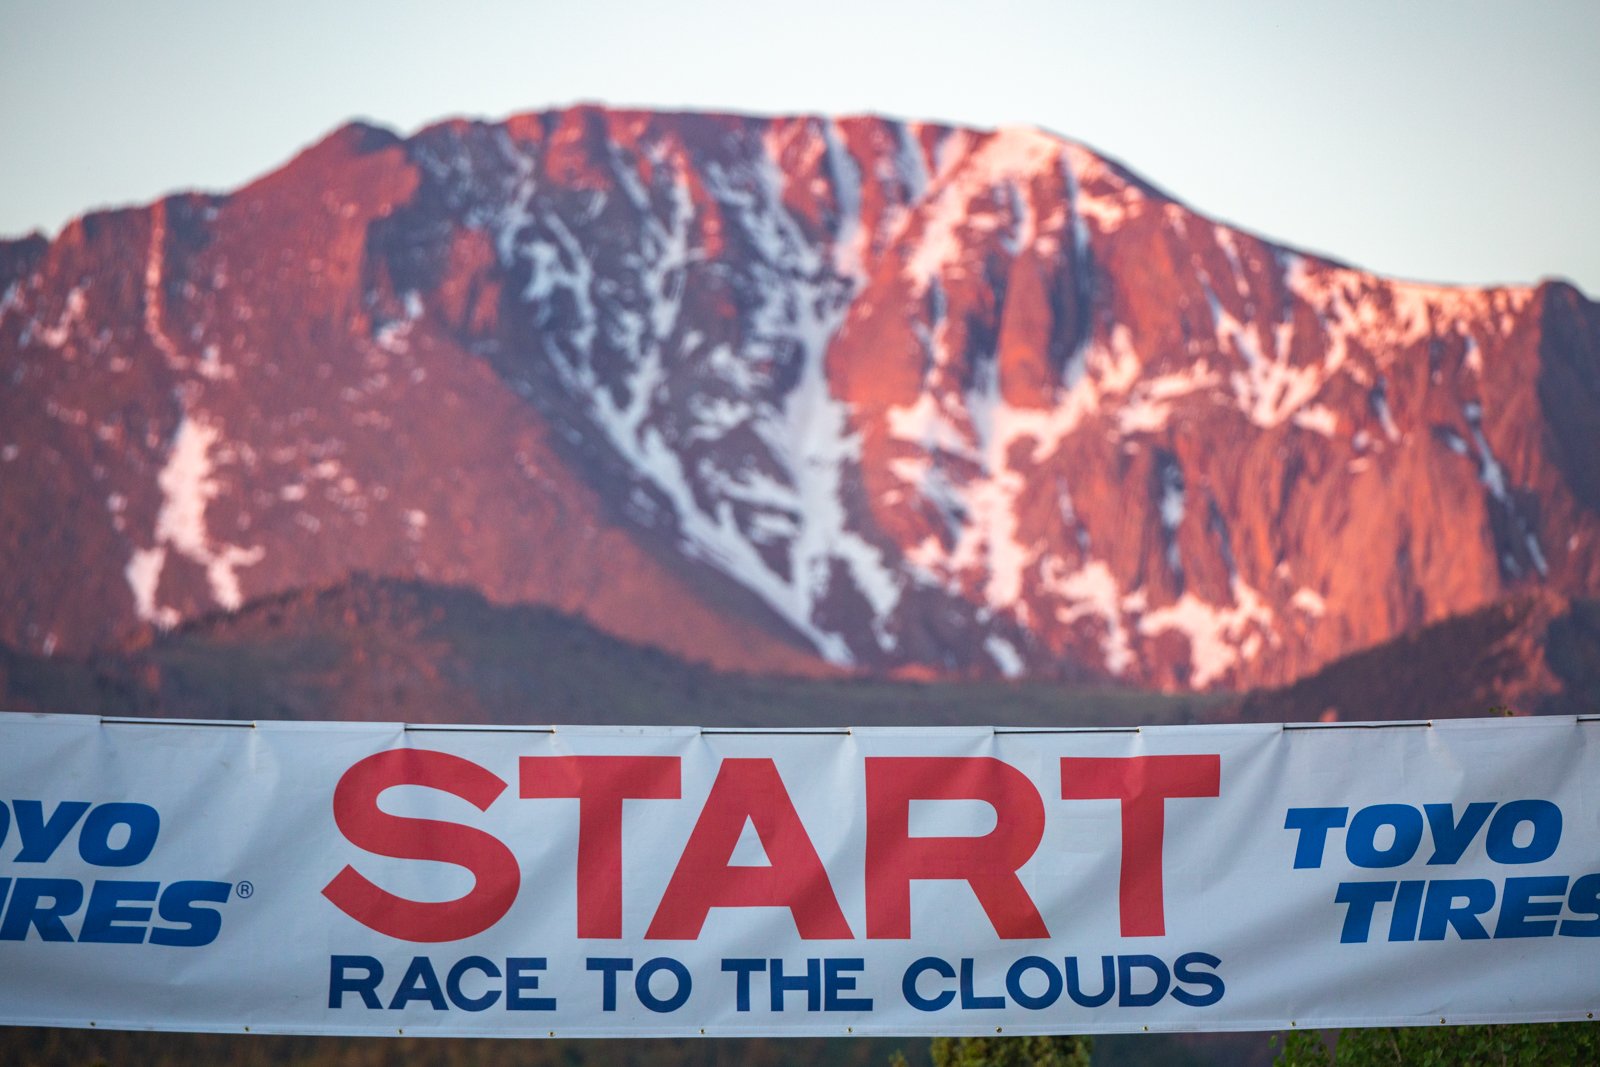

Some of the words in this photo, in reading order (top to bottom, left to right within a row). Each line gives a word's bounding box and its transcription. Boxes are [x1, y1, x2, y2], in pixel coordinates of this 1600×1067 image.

[0, 799, 160, 868] YO
[321, 748, 1221, 942] START
[1283, 799, 1563, 870] TOYO
[328, 954, 557, 1012] RACE
[586, 956, 693, 1013] TO
[720, 957, 874, 1012] THE
[902, 951, 1226, 1012] CLOUDS
